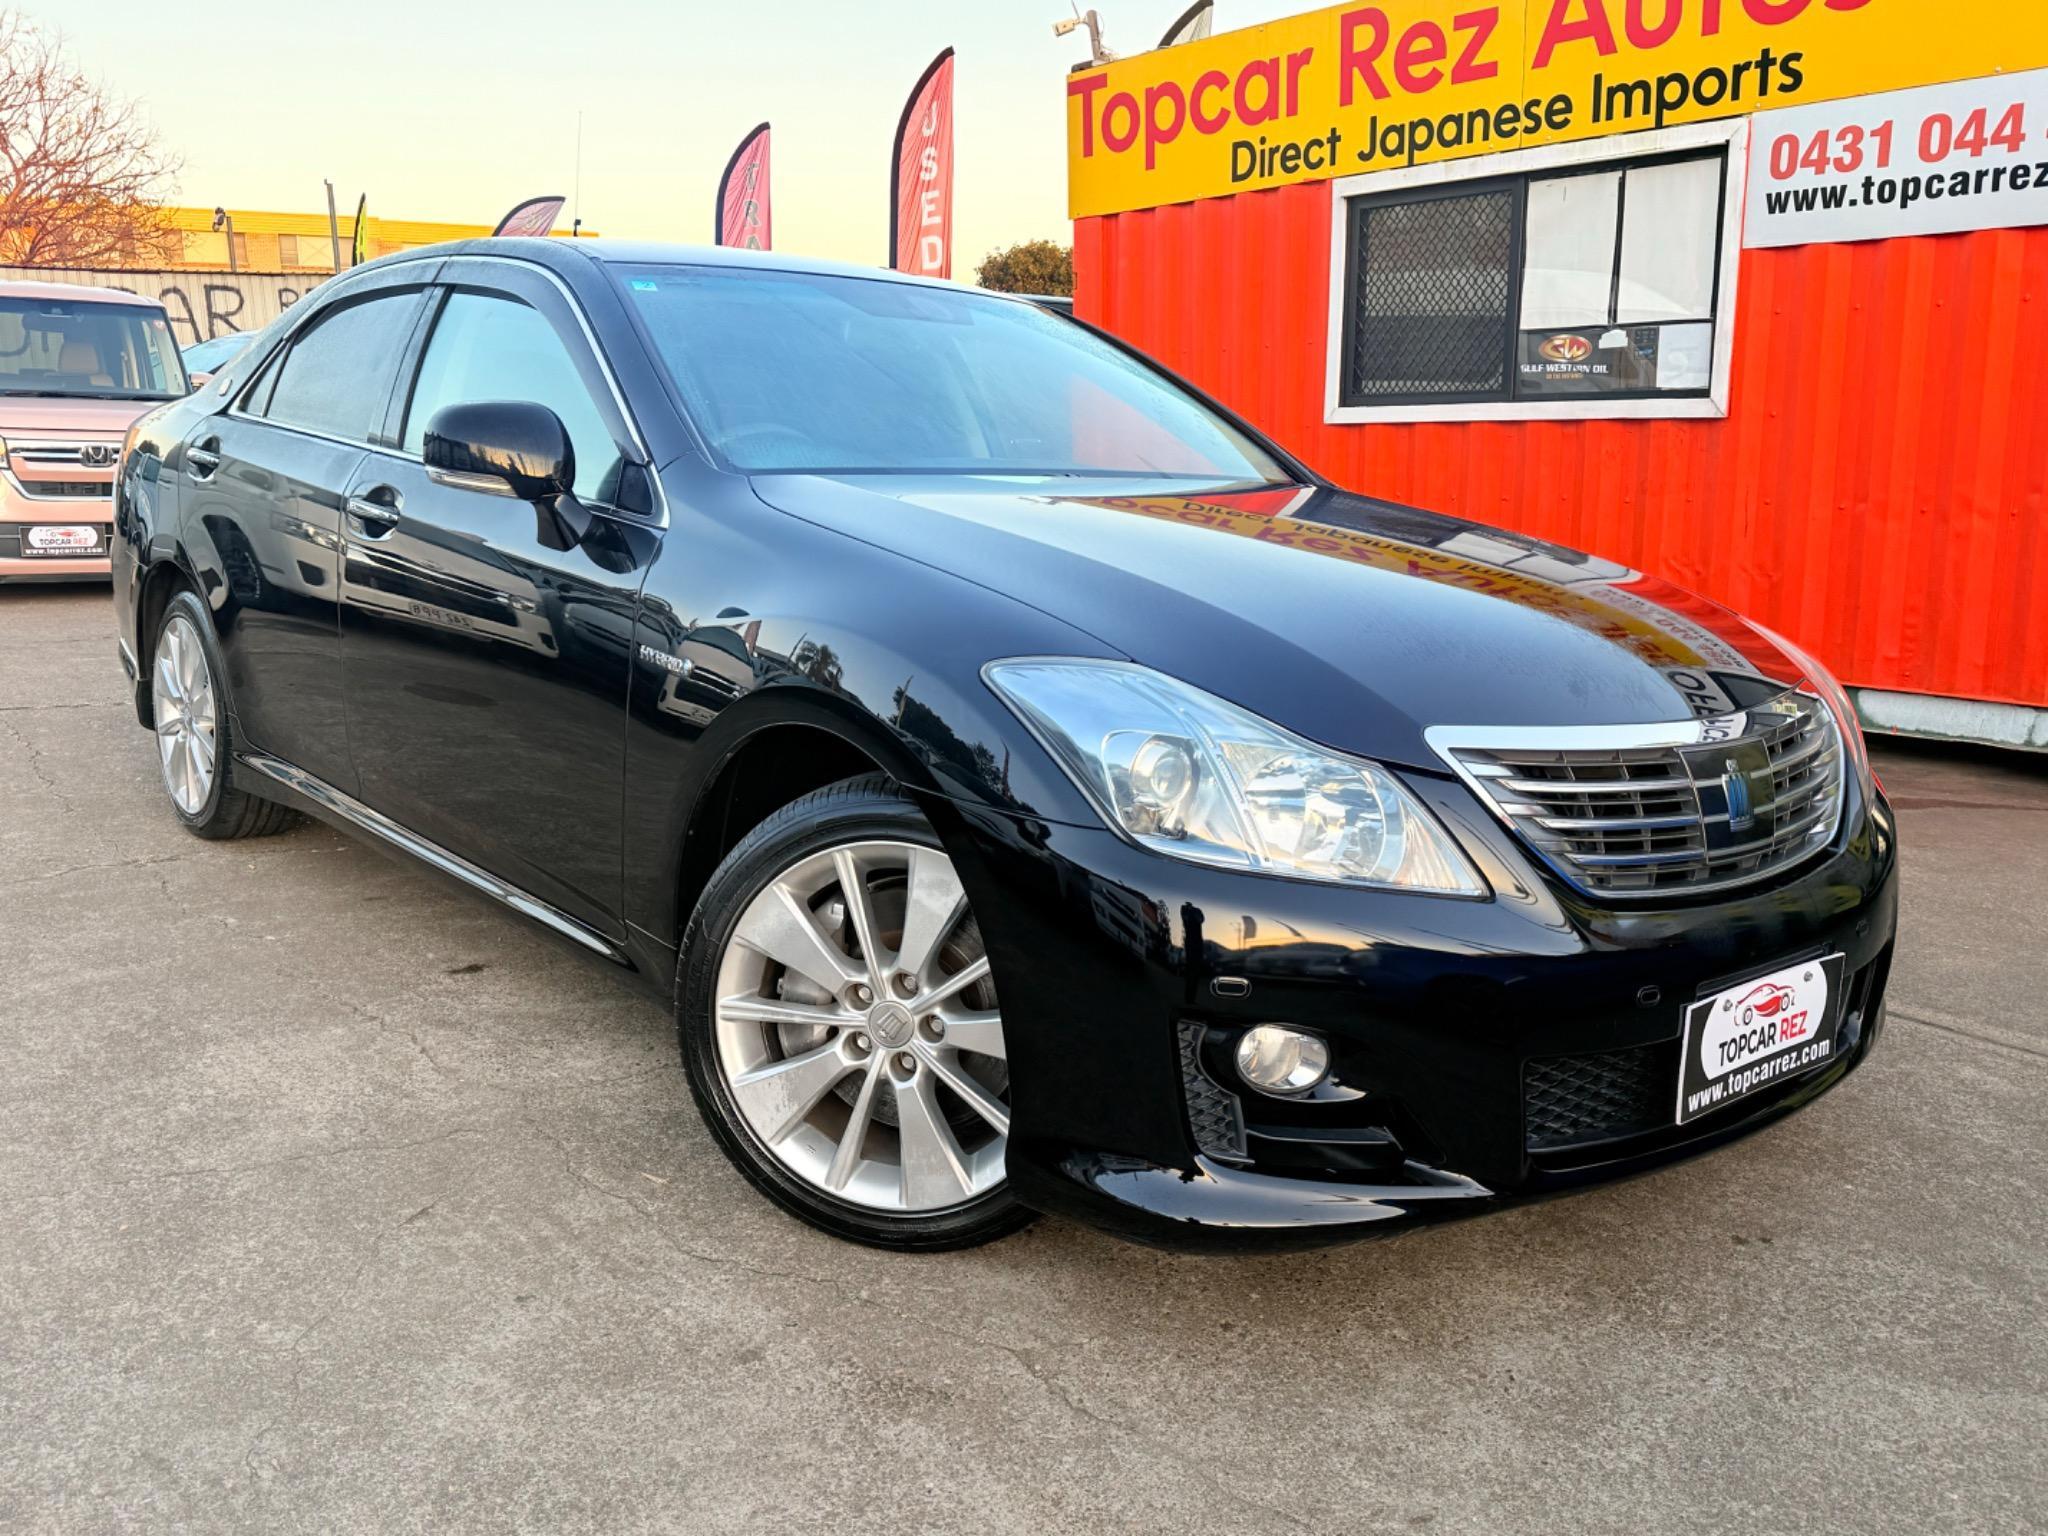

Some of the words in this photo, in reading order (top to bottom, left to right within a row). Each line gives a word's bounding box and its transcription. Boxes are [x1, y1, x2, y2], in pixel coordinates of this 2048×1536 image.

[1068, 47, 1315, 171] Topcar
[1339, 6, 1500, 108] Rez
[1231, 127, 1342, 183] Direct
[1356, 93, 1574, 167] Japanese
[1591, 47, 1804, 129] Imports
[1769, 119, 1894, 180] 0431
[1918, 102, 2026, 163] 044
[1592, 364, 1609, 374] OIL
[39, 538, 72, 546] TOPCAR
[1719, 1022, 1778, 1067] TOPCAR
[1779, 1010, 1809, 1042] REZ
[1688, 1039, 1831, 1112] www.topcarrez.com
